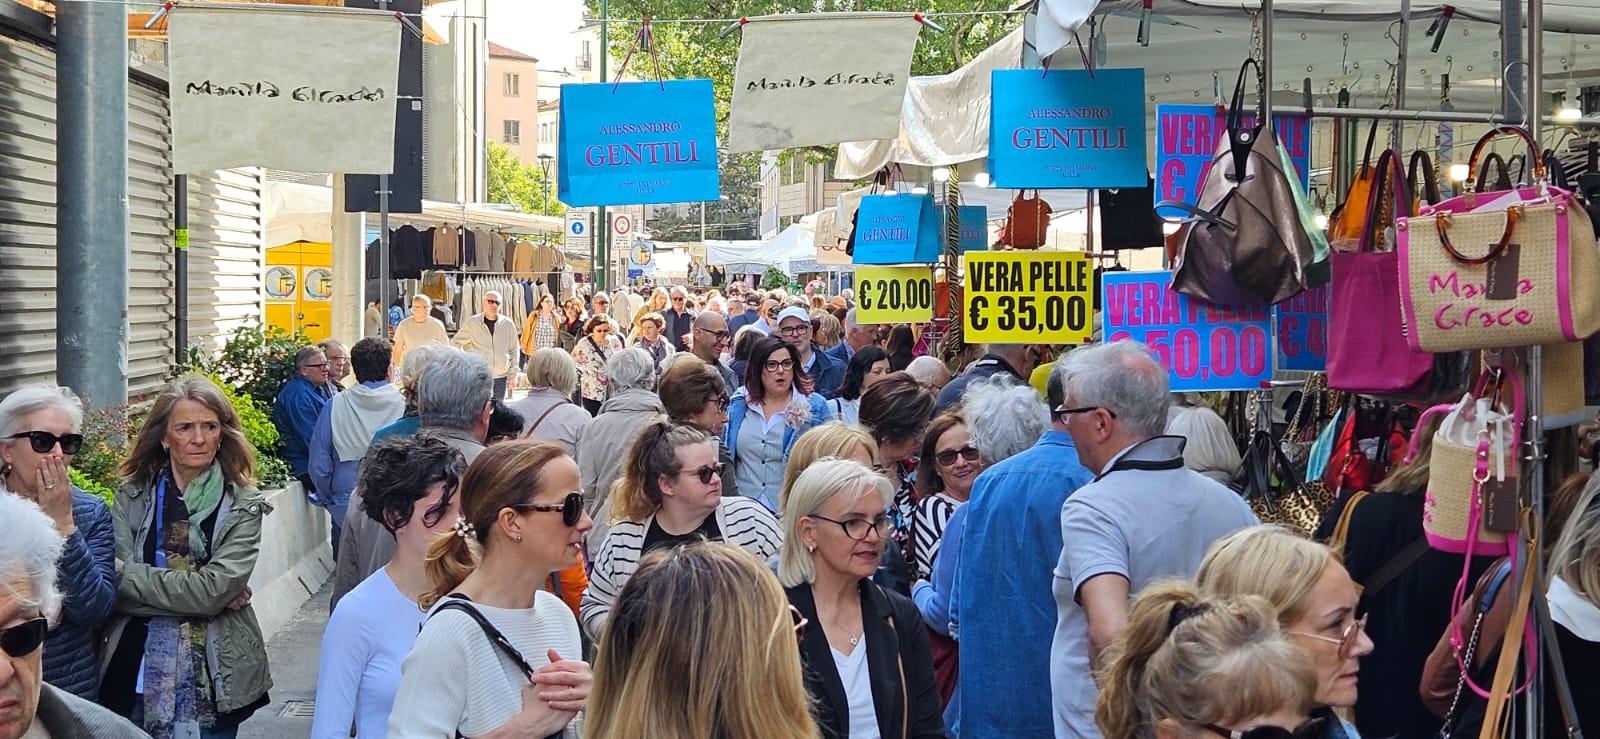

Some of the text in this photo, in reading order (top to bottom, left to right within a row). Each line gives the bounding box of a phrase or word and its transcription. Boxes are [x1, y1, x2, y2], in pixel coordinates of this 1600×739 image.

[1028, 107, 1111, 119] ALESSANDRO
[600, 121, 681, 136] ALESSANDRO
[1012, 127, 1127, 150] GENTILI
[585, 140, 699, 168] GENTILI
[863, 226, 910, 241] GENTILI
[969, 261, 1087, 292] VERA PELLE
[859, 278, 930, 312] € 20,00
[1106, 283, 1180, 327] VERA
[968, 295, 1086, 335] € 35,00
[1434, 303, 1533, 330] Grace
